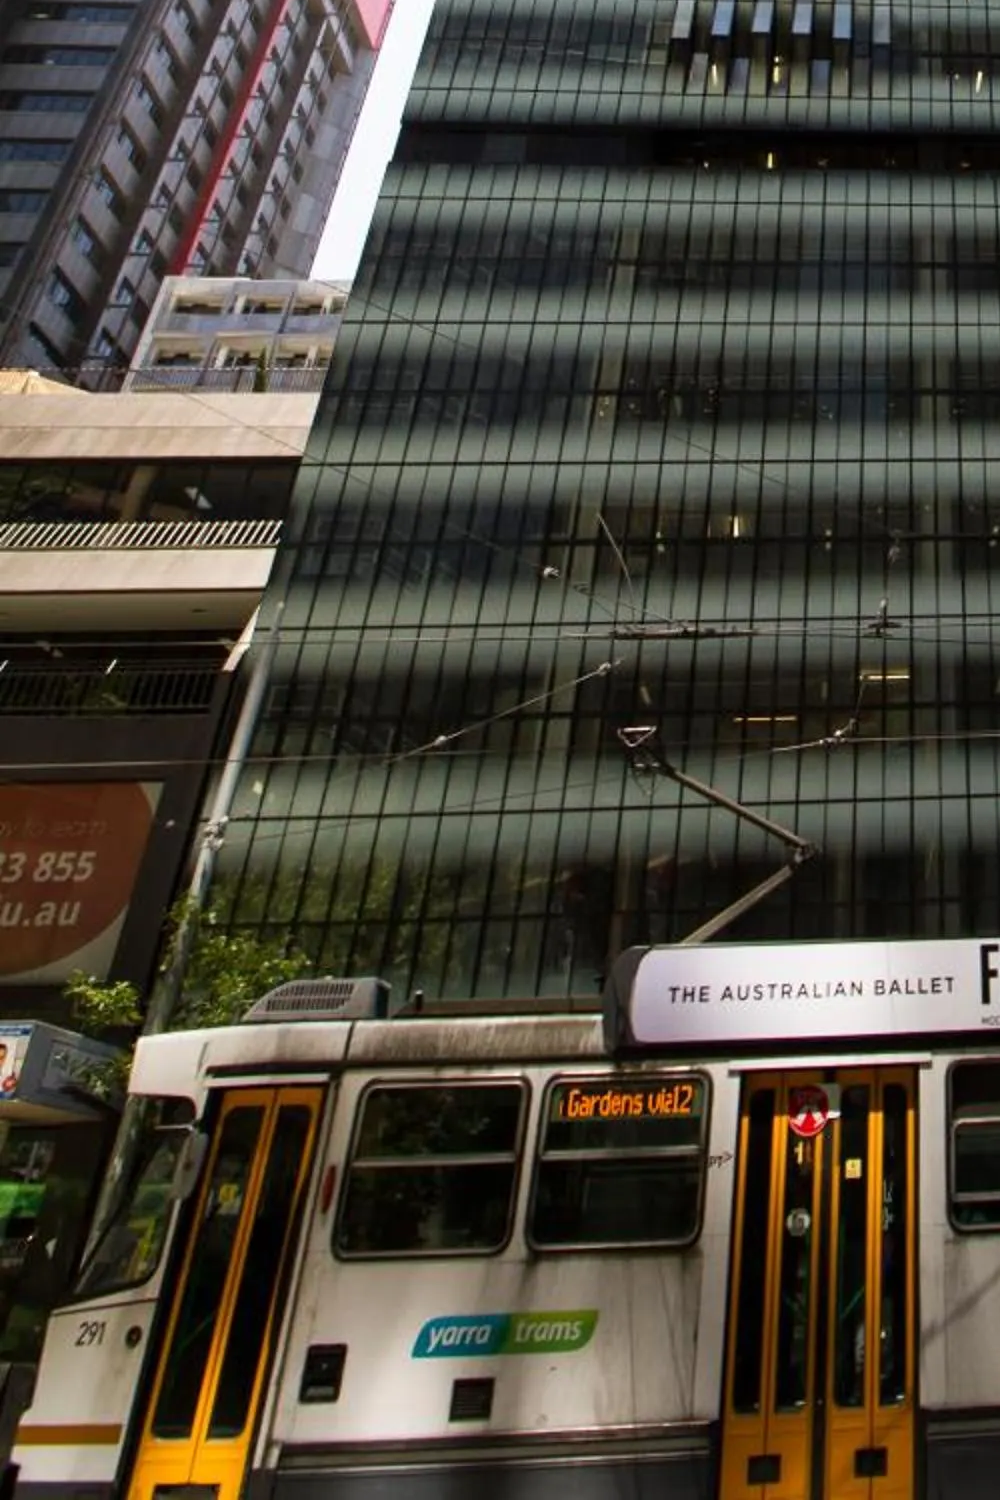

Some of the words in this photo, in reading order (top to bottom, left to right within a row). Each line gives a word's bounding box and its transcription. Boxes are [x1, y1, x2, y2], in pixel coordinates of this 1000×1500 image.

[0, 852, 27, 883] 3
[32, 851, 97, 883] 855
[668, 985, 710, 1004] THE
[720, 980, 863, 1002] AUSTRALIAN
[873, 976, 956, 996] BALLET
[567, 1088, 643, 1118] Gardens
[74, 1321, 107, 1347] 291
[427, 1323, 493, 1353] yarra
[515, 1320, 584, 1343] trams
